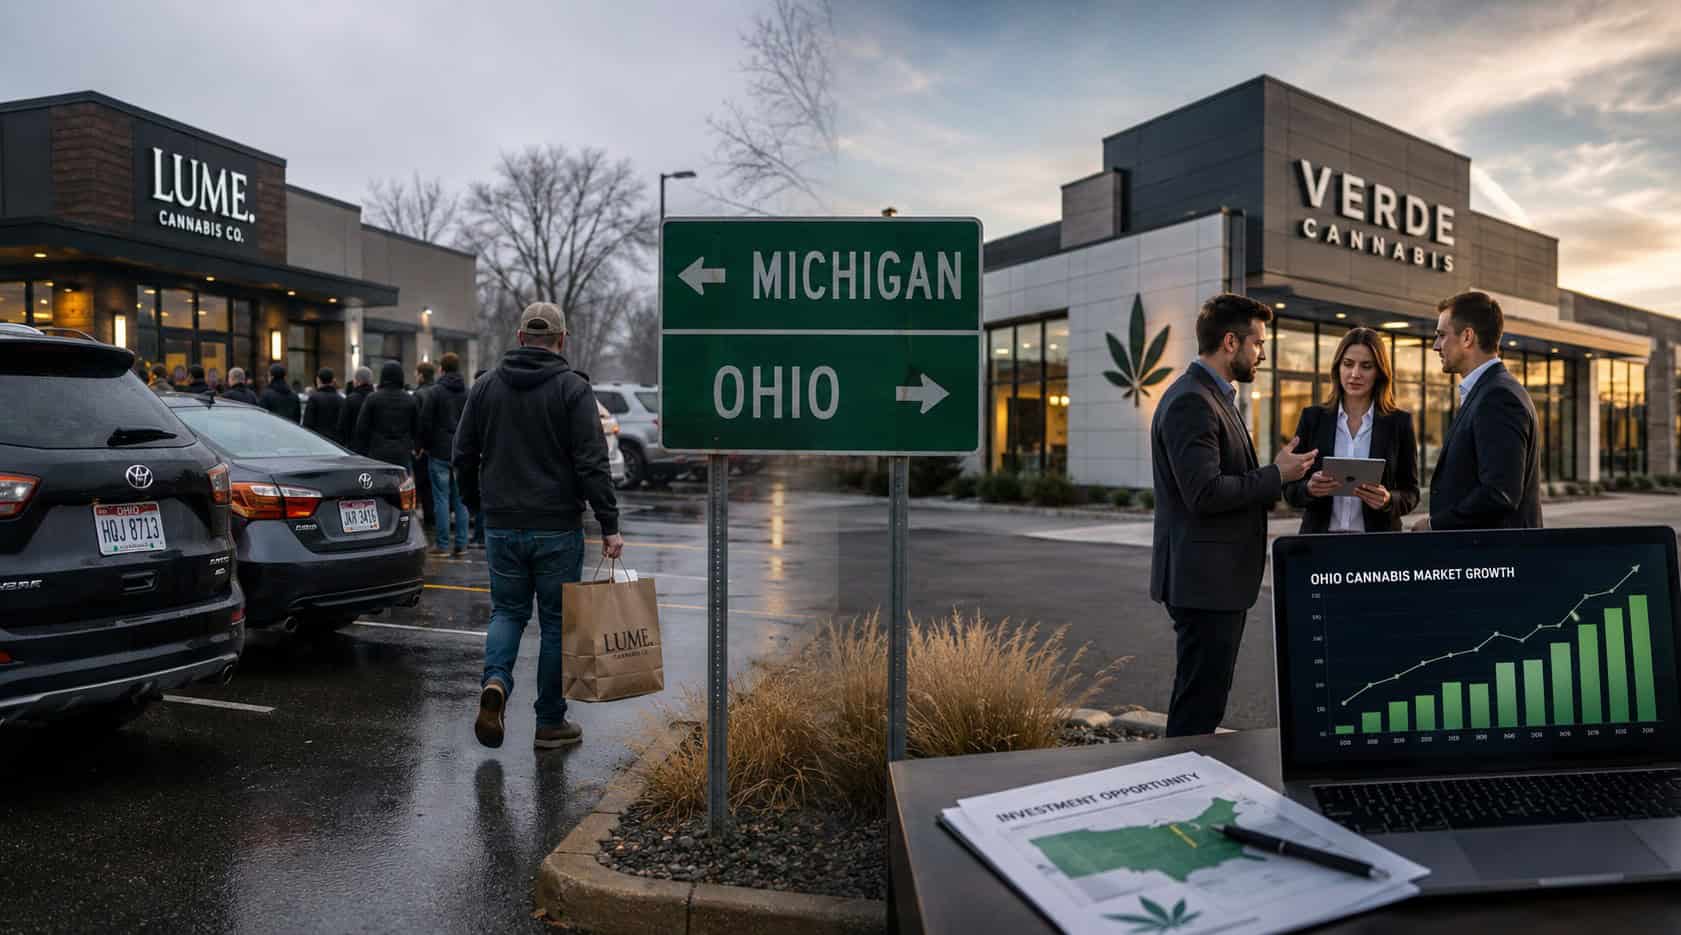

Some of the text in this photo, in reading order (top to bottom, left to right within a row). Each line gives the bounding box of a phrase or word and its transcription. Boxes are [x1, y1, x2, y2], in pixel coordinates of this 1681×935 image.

[152, 147, 256, 224] LUME.
[1300, 159, 1455, 247] VERDE
[159, 209, 245, 243] CANNABIS CO.
[1303, 217, 1454, 273] CANNABIS
[752, 250, 962, 300] MICHIGAN
[713, 365, 840, 419] OHIO
[101, 516, 160, 543] HQJ 8713
[117, 504, 140, 516] OHIO
[1310, 566, 1515, 585] OHIO CANNABIS MARKET GROWTH
[994, 771, 1201, 824] INVESTMENT OPPORTUNITY
